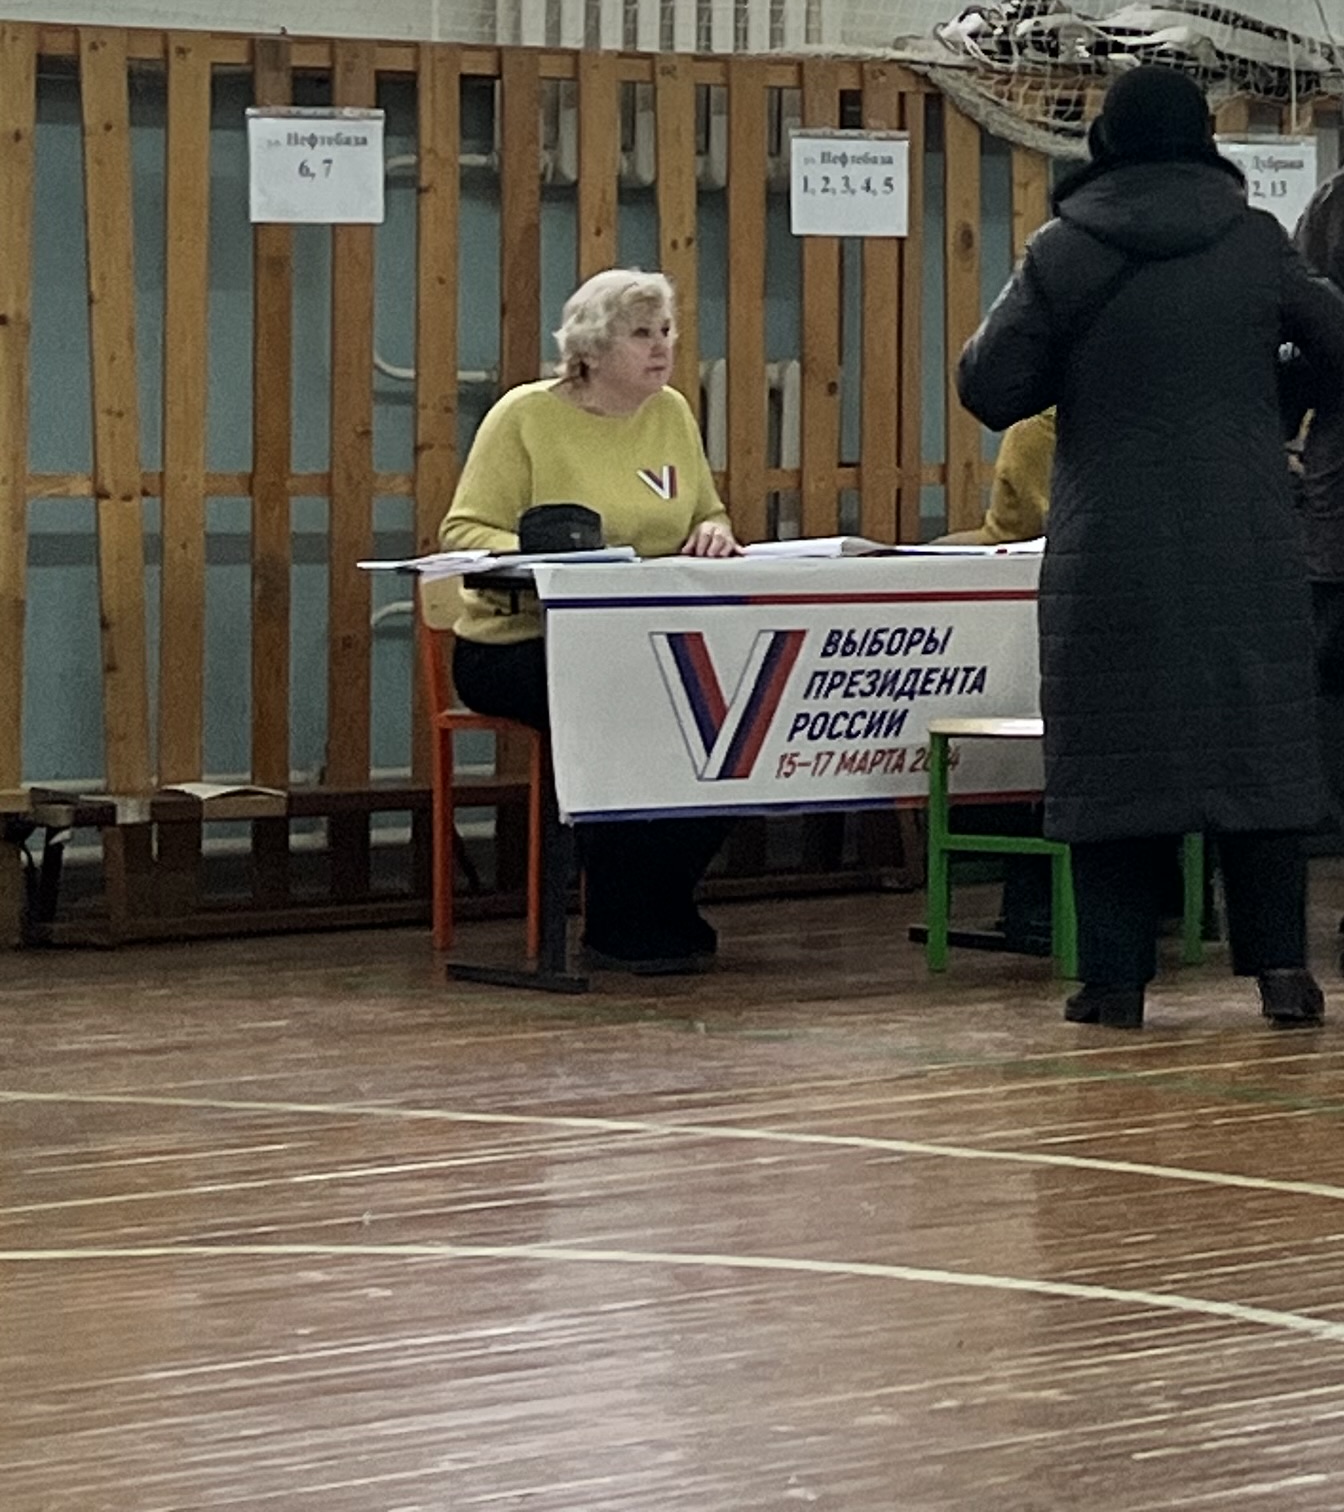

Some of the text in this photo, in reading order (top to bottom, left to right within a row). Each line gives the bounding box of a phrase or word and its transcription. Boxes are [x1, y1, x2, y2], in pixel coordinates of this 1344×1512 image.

[286, 132, 368, 150] Нефтебаза
[298, 159, 333, 181] 6, 7
[820, 151, 894, 168] Нефтебаза
[803, 175, 895, 196] 1, 2, 3, 4, 5
[1271, 180, 1287, 197] 13
[820, 626, 953, 658] ВЫБОРЫ
[803, 665, 988, 701] ПРЕЗИДЕНТА
[787, 708, 909, 742] РОССИИ
[775, 751, 836, 780] 15–17
[834, 747, 907, 776] МАРТА
